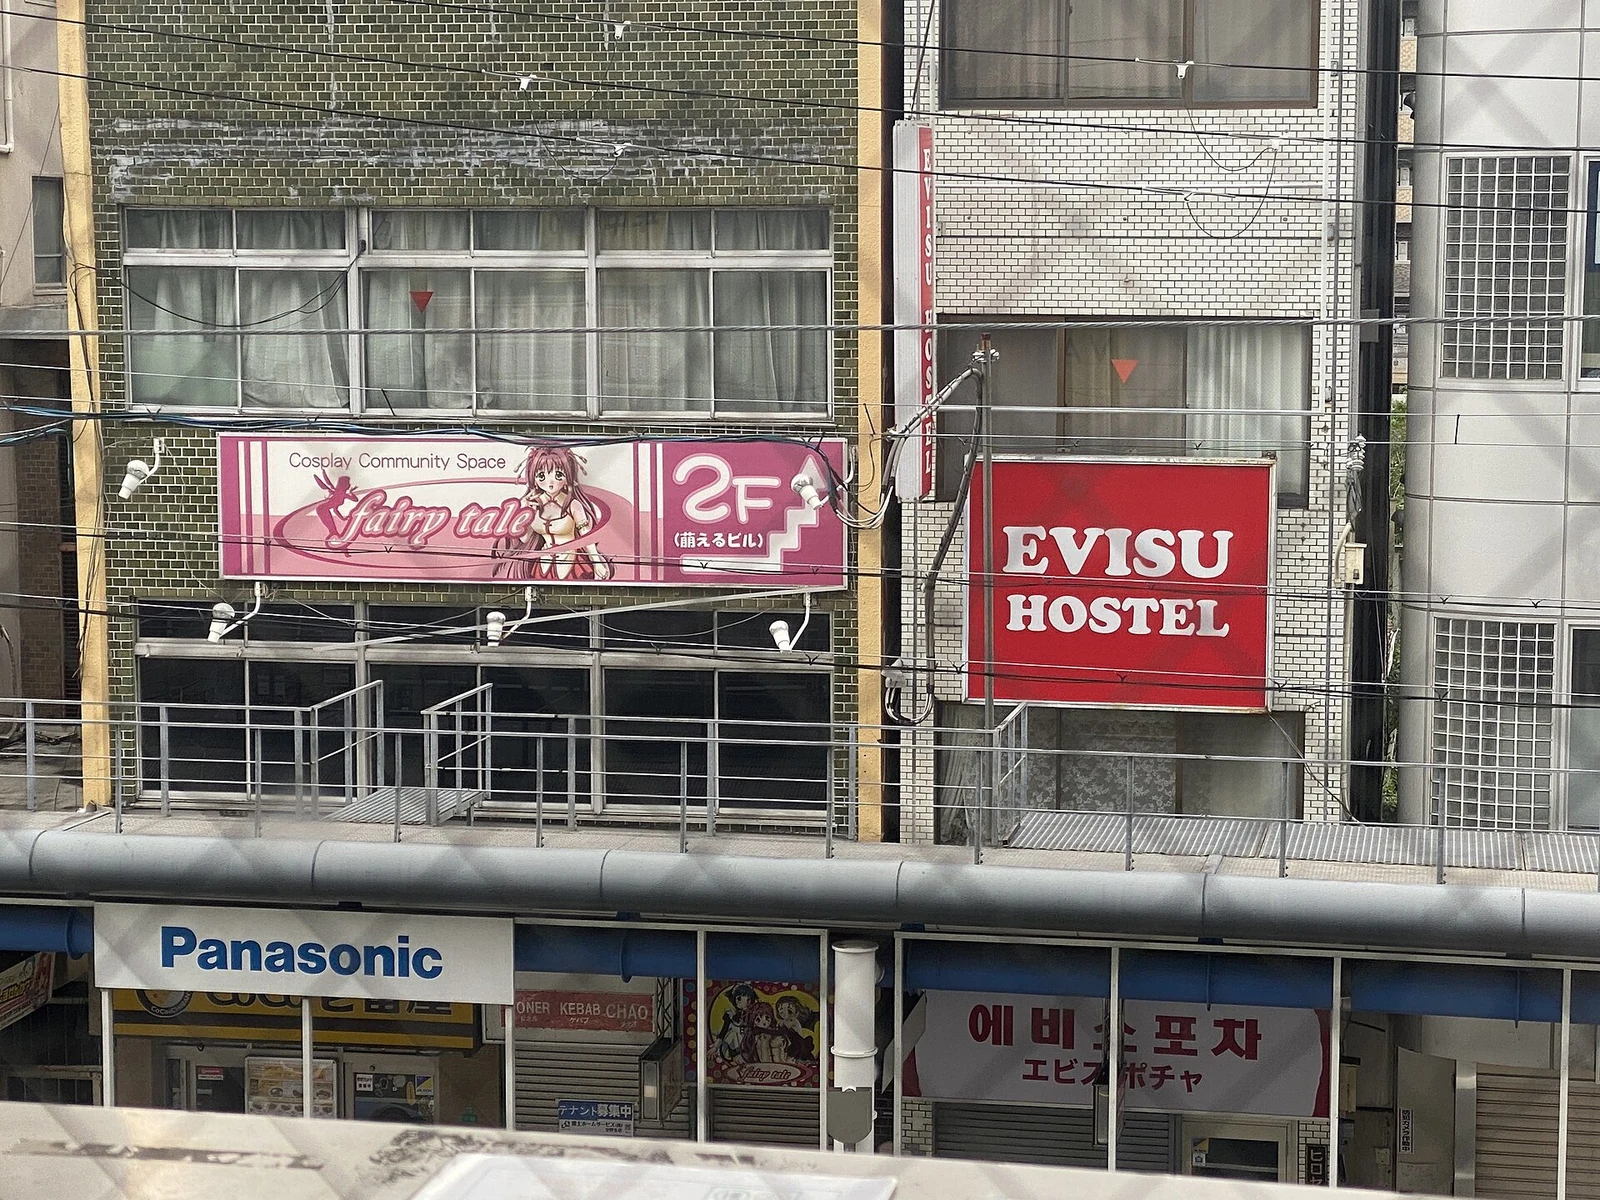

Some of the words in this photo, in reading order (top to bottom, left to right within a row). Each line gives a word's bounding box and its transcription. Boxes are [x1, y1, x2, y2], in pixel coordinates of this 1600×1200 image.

[923, 149, 932, 285] EVISU
[289, 452, 353, 471] Cosplay
[358, 453, 452, 472] Community
[457, 454, 507, 472] Space
[672, 453, 782, 524] 2F
[328, 488, 451, 547] fairy
[454, 490, 537, 540] tale
[673, 532, 764, 549] (萌えるビル)
[1002, 525, 1234, 578] EVISU
[1006, 593, 1230, 638] HOSTEL
[160, 926, 443, 980] Panasonic
[516, 1000, 551, 1015] ONER
[560, 1002, 601, 1016] KEBAB
[605, 1003, 648, 1020] CHAO
[741, 1066, 770, 1081] fairy
[770, 1069, 791, 1080] tale
[558, 1103, 632, 1119] テナント募集中
